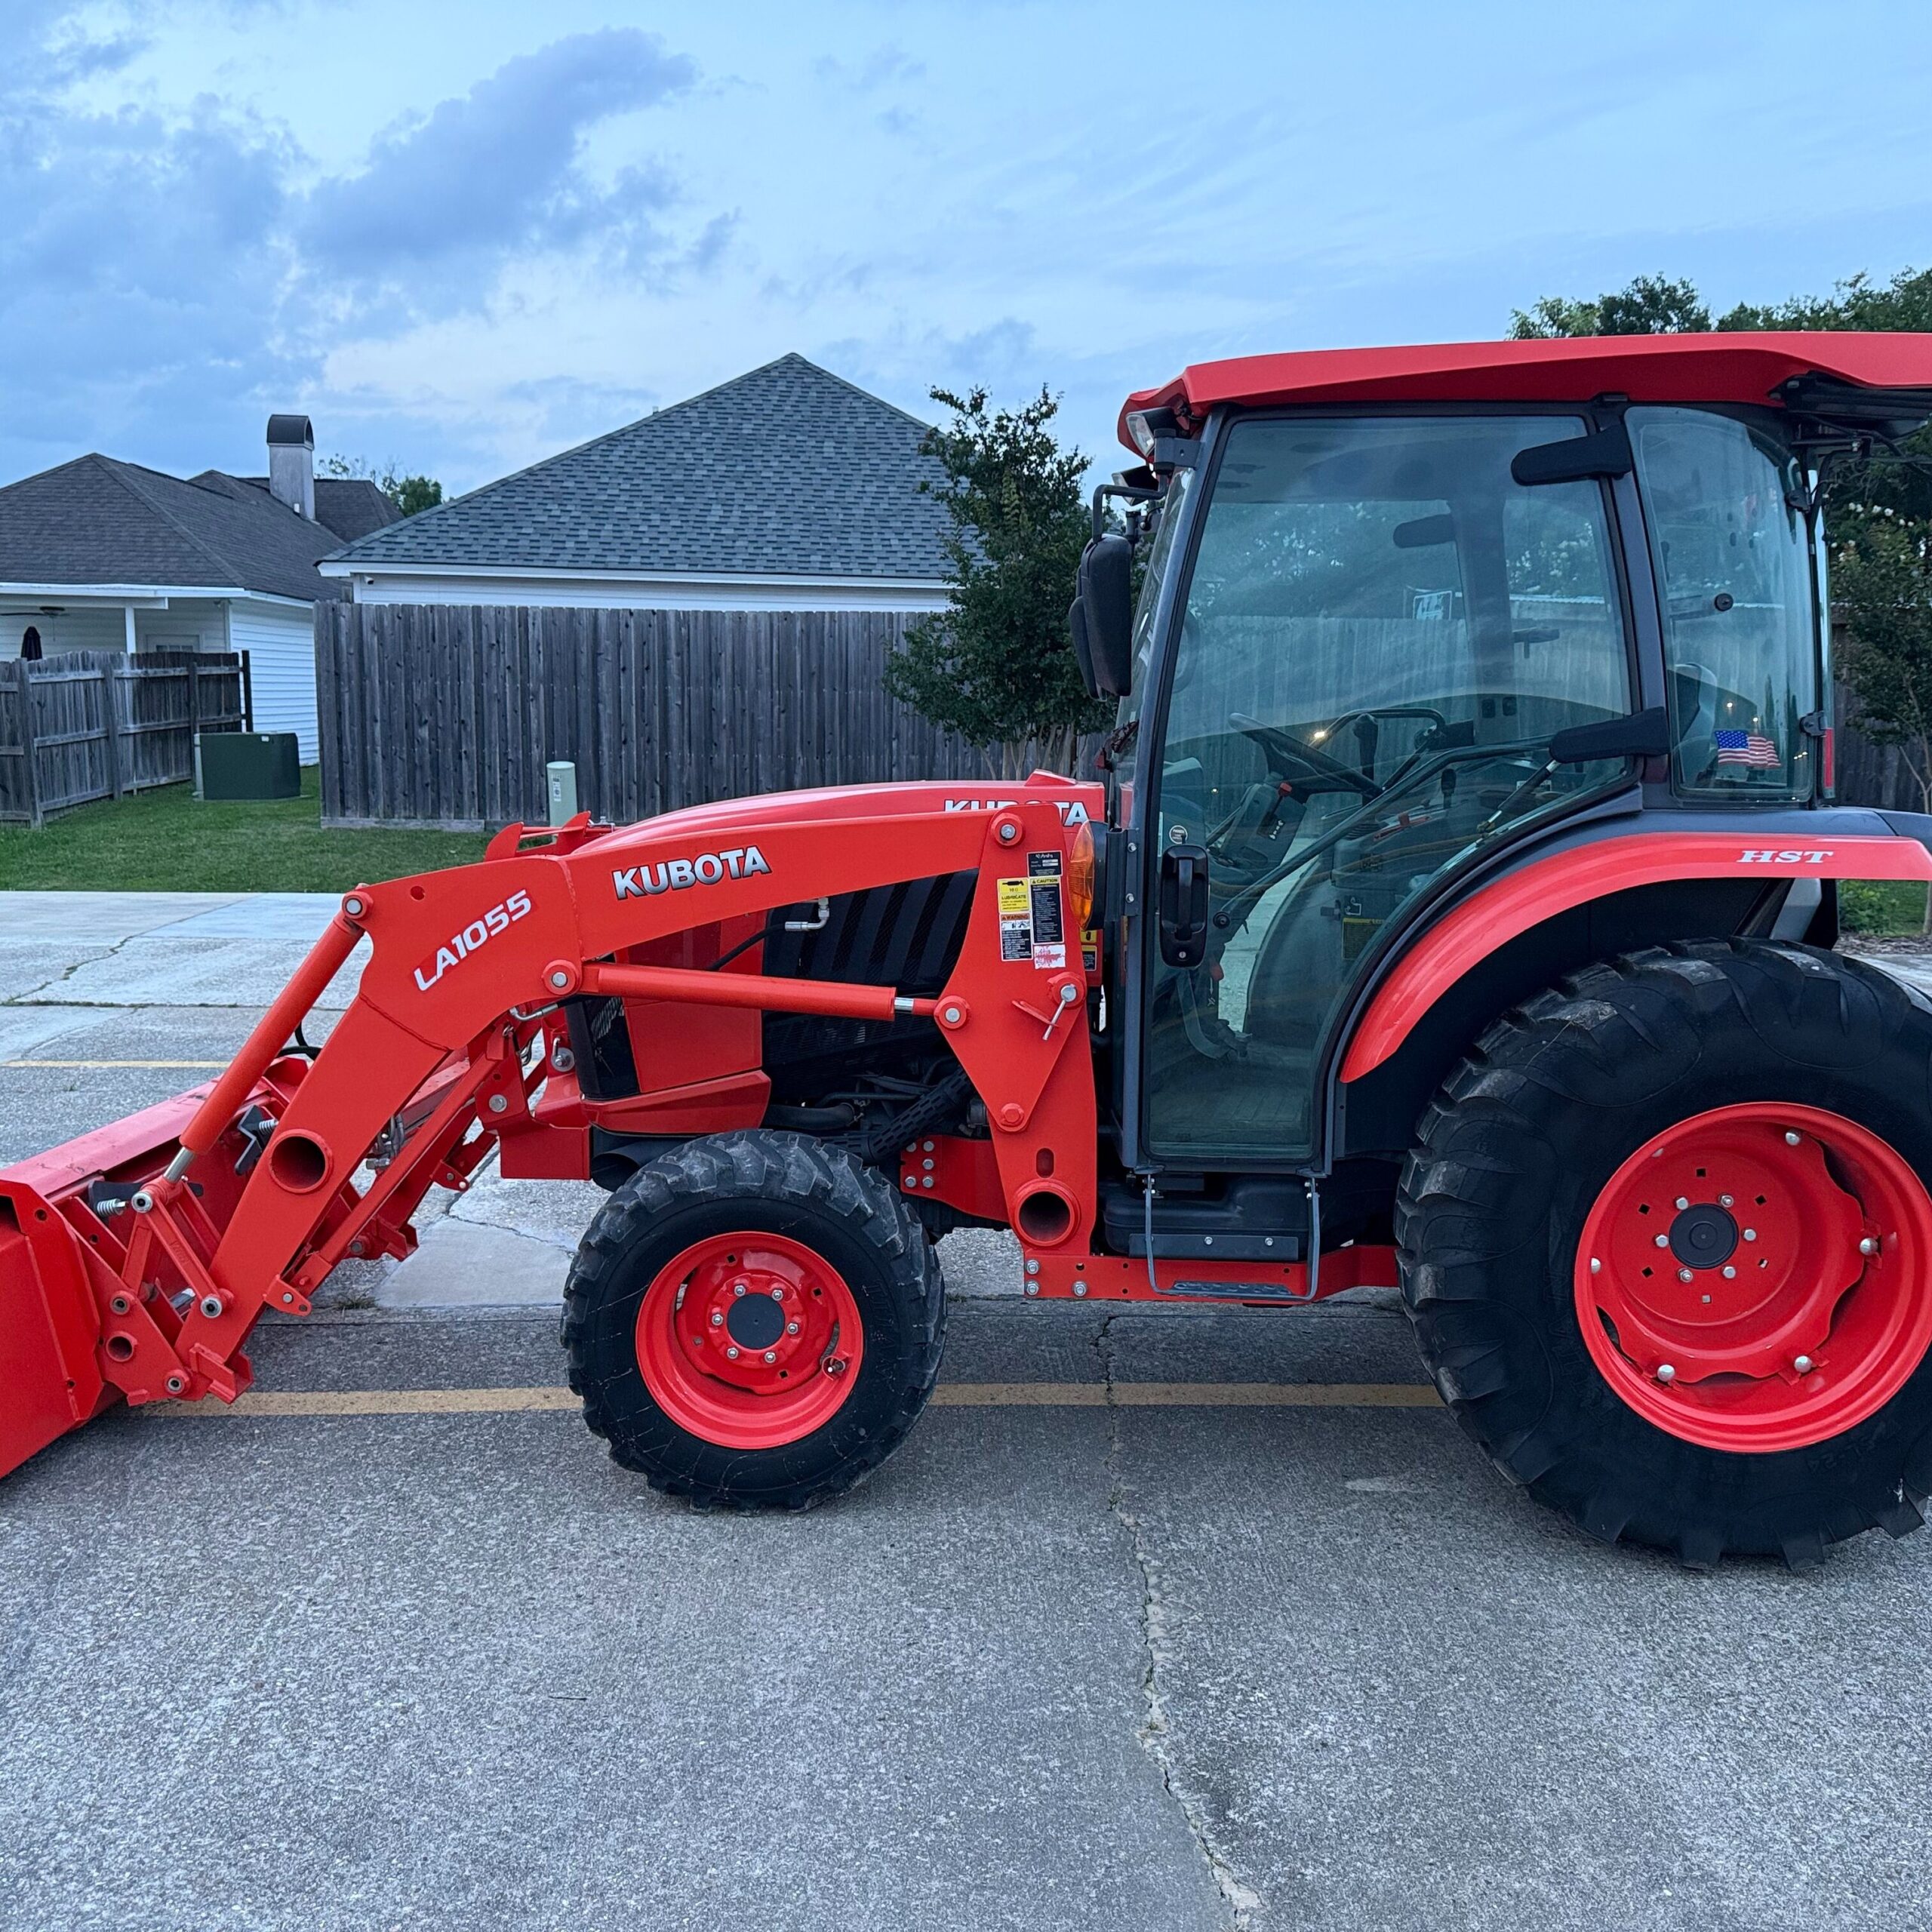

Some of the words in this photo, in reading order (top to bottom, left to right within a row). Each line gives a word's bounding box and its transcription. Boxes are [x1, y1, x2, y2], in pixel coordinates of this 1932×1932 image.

[611, 845, 772, 900] KUBOTA
[1737, 850, 1834, 863] HST
[414, 889, 532, 992] LA1055
